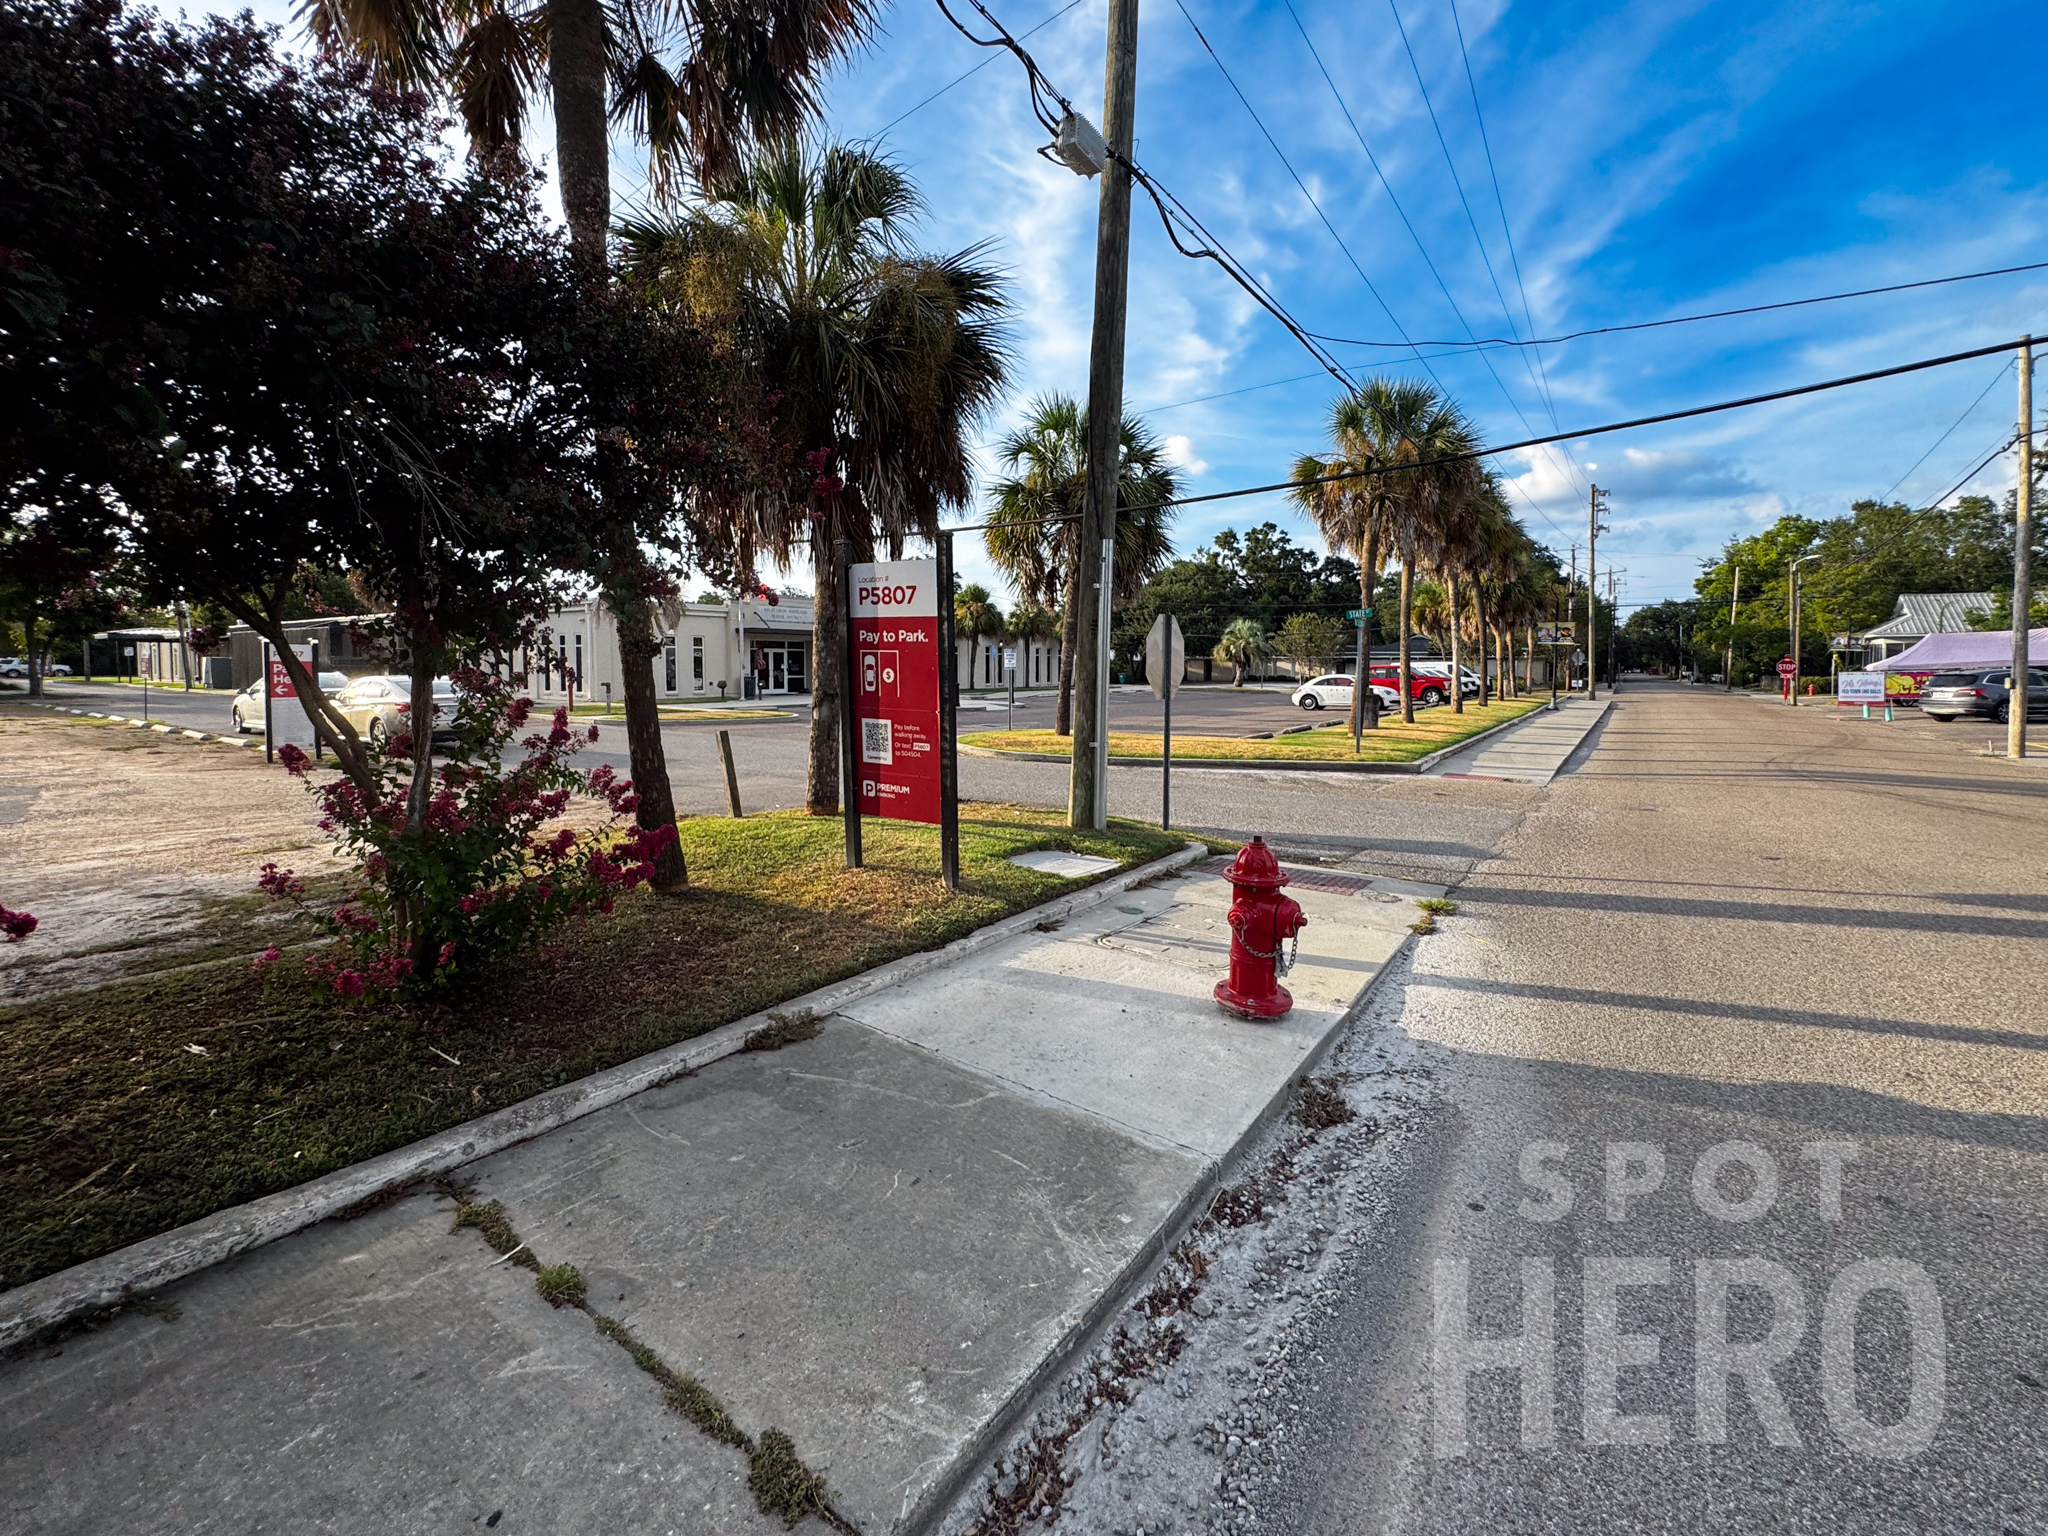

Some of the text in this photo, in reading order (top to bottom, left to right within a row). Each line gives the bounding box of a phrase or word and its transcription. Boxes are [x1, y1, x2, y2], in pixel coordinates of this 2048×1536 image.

[859, 585, 917, 605] P5807
[1349, 610, 1365, 618] STATE
[859, 629, 928, 645] Pay to Park.
[1778, 663, 1796, 671] STOP
[877, 783, 910, 794] PREMIUM
